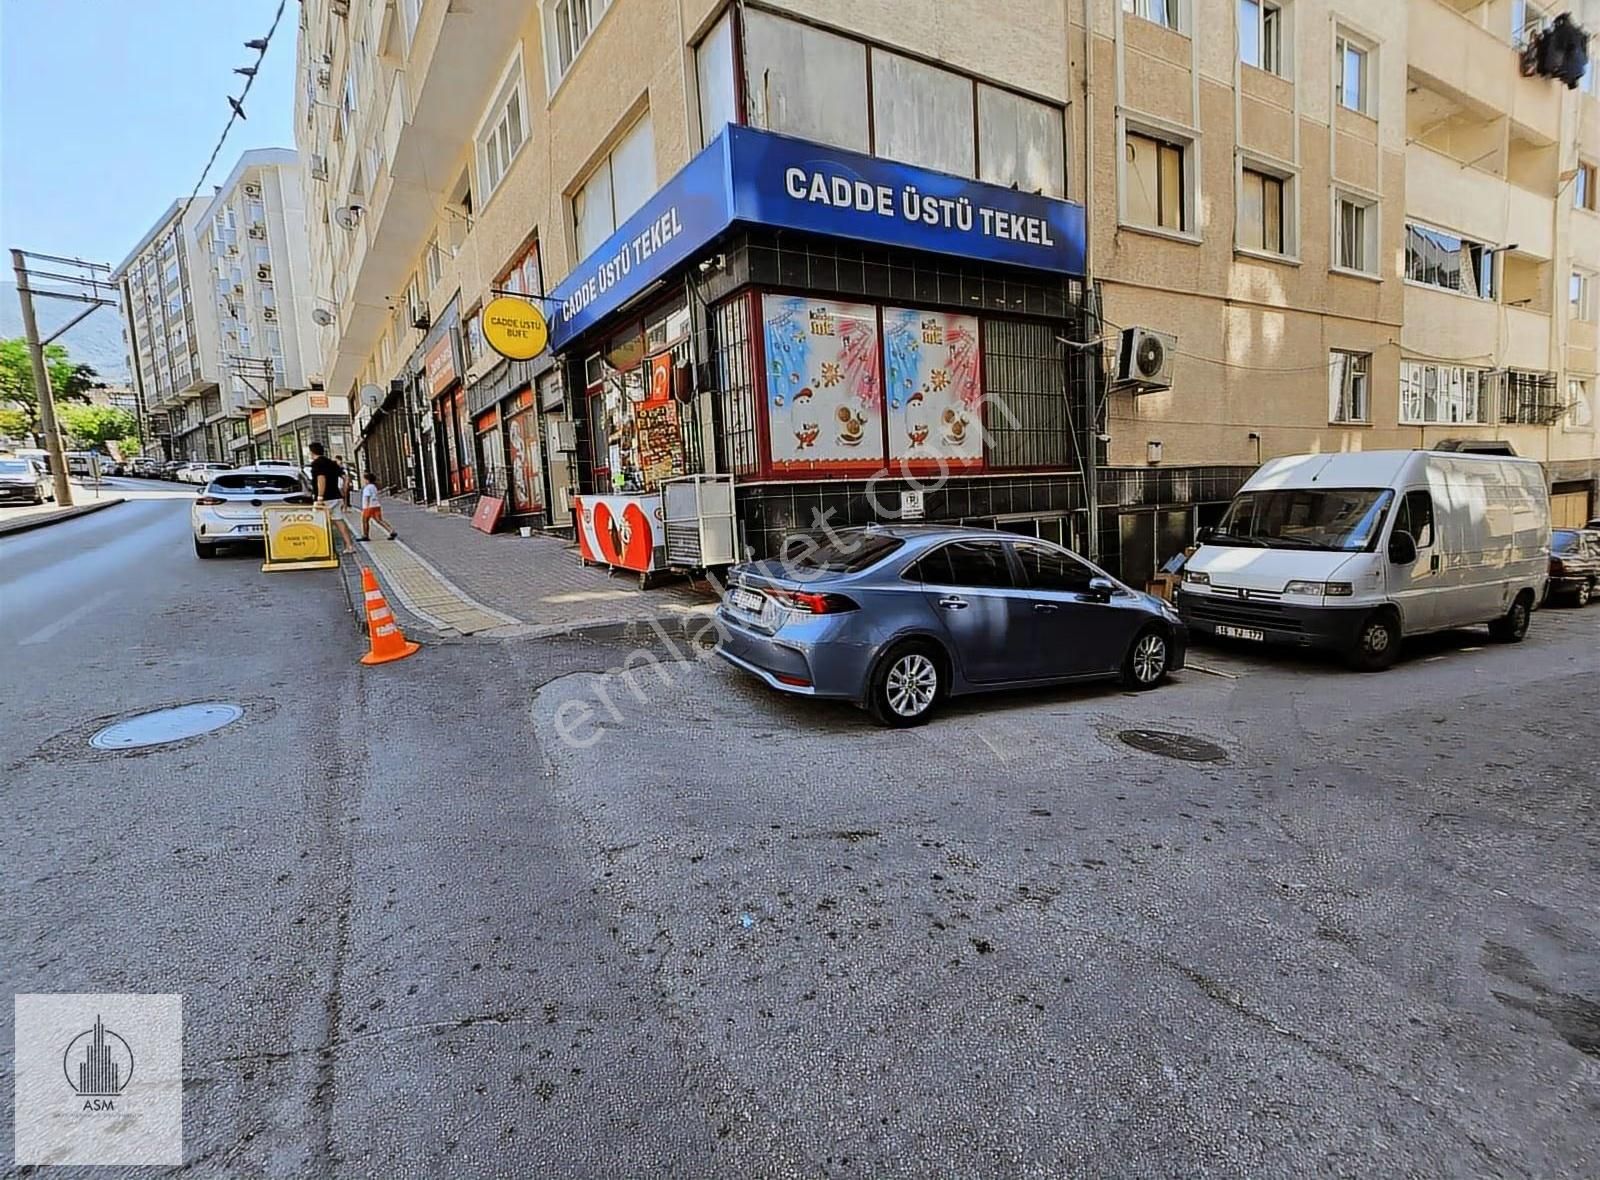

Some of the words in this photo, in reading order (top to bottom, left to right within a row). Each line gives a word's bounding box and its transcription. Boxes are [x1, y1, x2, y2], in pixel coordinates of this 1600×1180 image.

[785, 167, 894, 217] CADDE
[902, 185, 973, 231] ÜSTÜ
[979, 207, 1054, 246] TEKEL
[562, 276, 598, 322] CADDE
[598, 243, 631, 293] ÜSTÜ
[632, 207, 682, 265] TEKEL
